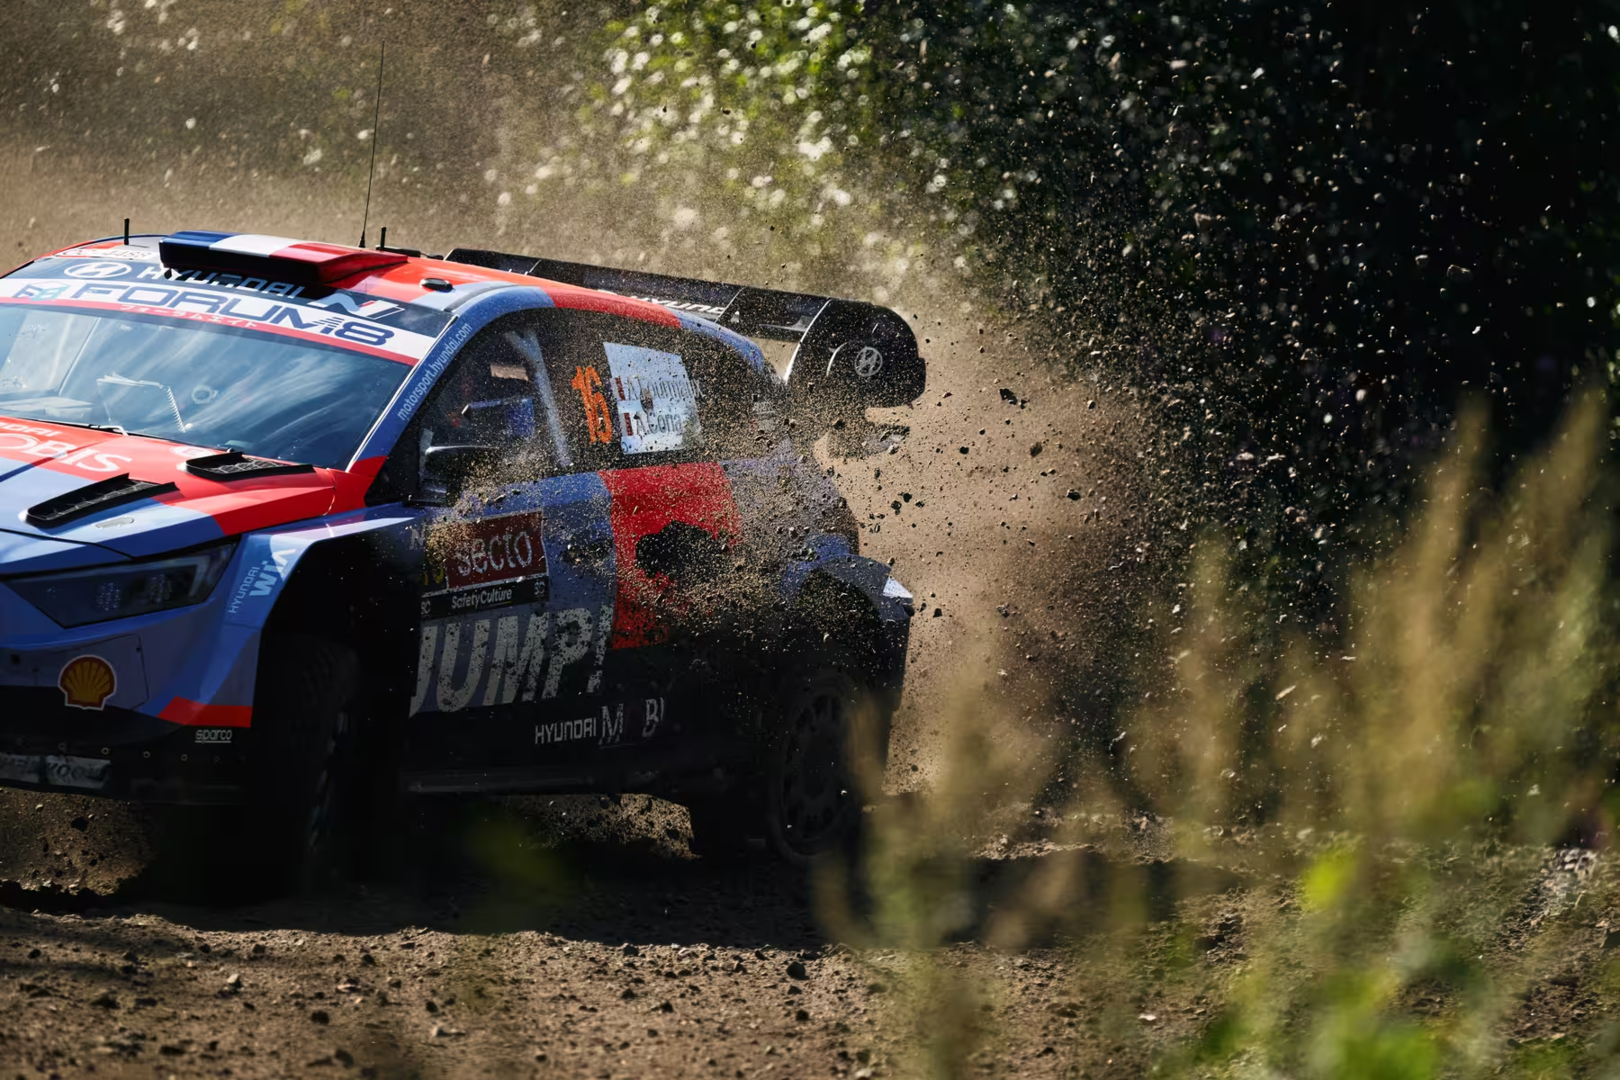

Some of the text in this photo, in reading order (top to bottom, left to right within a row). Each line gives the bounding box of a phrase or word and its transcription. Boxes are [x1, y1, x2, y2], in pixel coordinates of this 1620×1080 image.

[136, 266, 306, 299] HYUNDAI
[70, 283, 395, 346] FORUM8
[397, 322, 473, 421] motorsport.hyundai.com
[568, 366, 612, 444] 16
[228, 566, 260, 613] HYUNDAI
[451, 587, 513, 611] SafetyCulture
[408, 603, 614, 718] JUMP!
[195, 728, 233, 743] sparco
[534, 716, 597, 745] HYUNDAI
